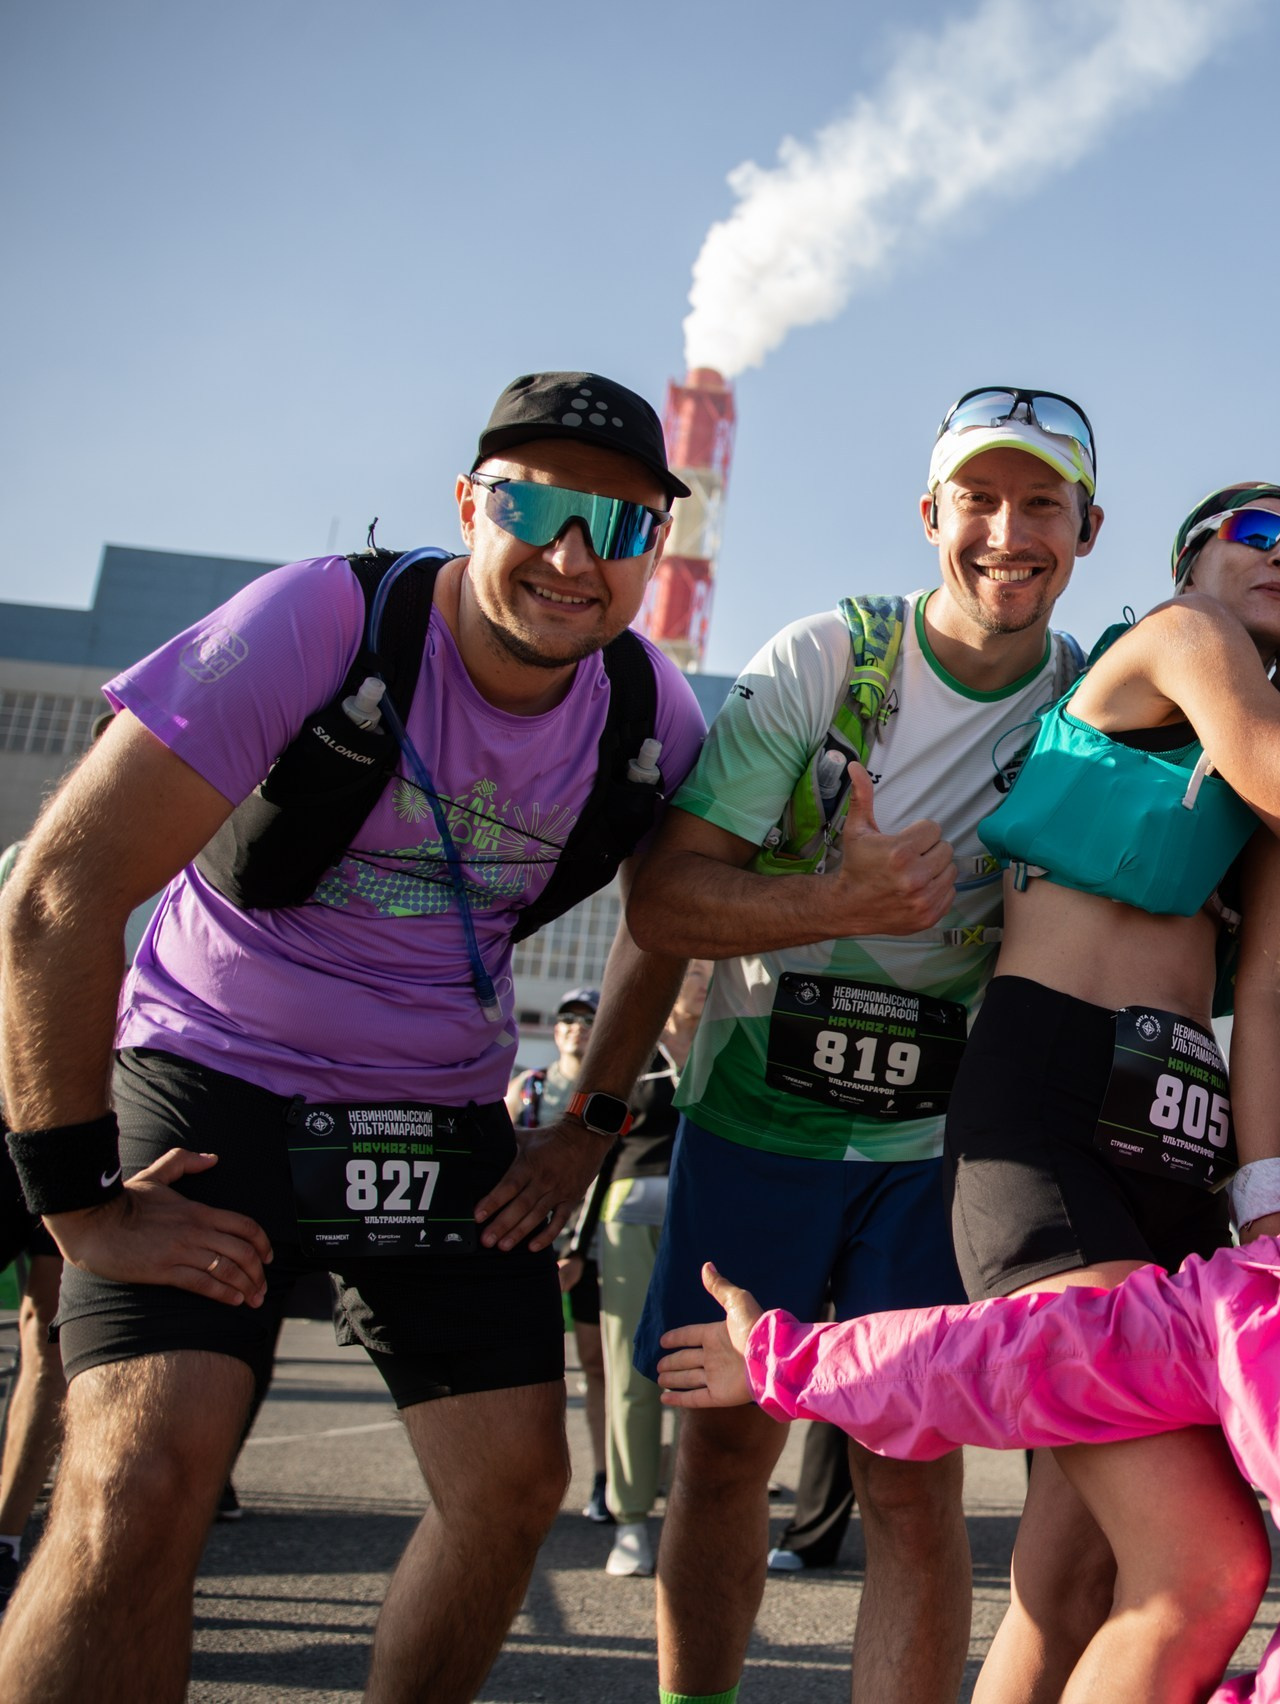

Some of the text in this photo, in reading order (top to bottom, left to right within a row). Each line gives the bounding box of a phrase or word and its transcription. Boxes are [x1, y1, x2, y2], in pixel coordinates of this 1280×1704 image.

[313, 725, 376, 766] SALOMON
[832, 997, 918, 1022] УЛЬТРАМАРАФОН
[833, 985, 920, 1010] НЕВИННОМЫССКИЙ
[813, 1030, 921, 1086] 819
[828, 1076, 895, 1096] УЛЬТРАМАРАФОН
[348, 1109, 433, 1123] НЕВИННОМЫССКИЙ
[1149, 1073, 1230, 1148] 805
[350, 1122, 433, 1137] УЛЬТРАМАРАФОН
[1162, 1134, 1215, 1159] УЛЬТРАМАРАФОН
[345, 1159, 440, 1211] 827
[364, 1216, 425, 1224] УЛЬТРАМАРАФОН
